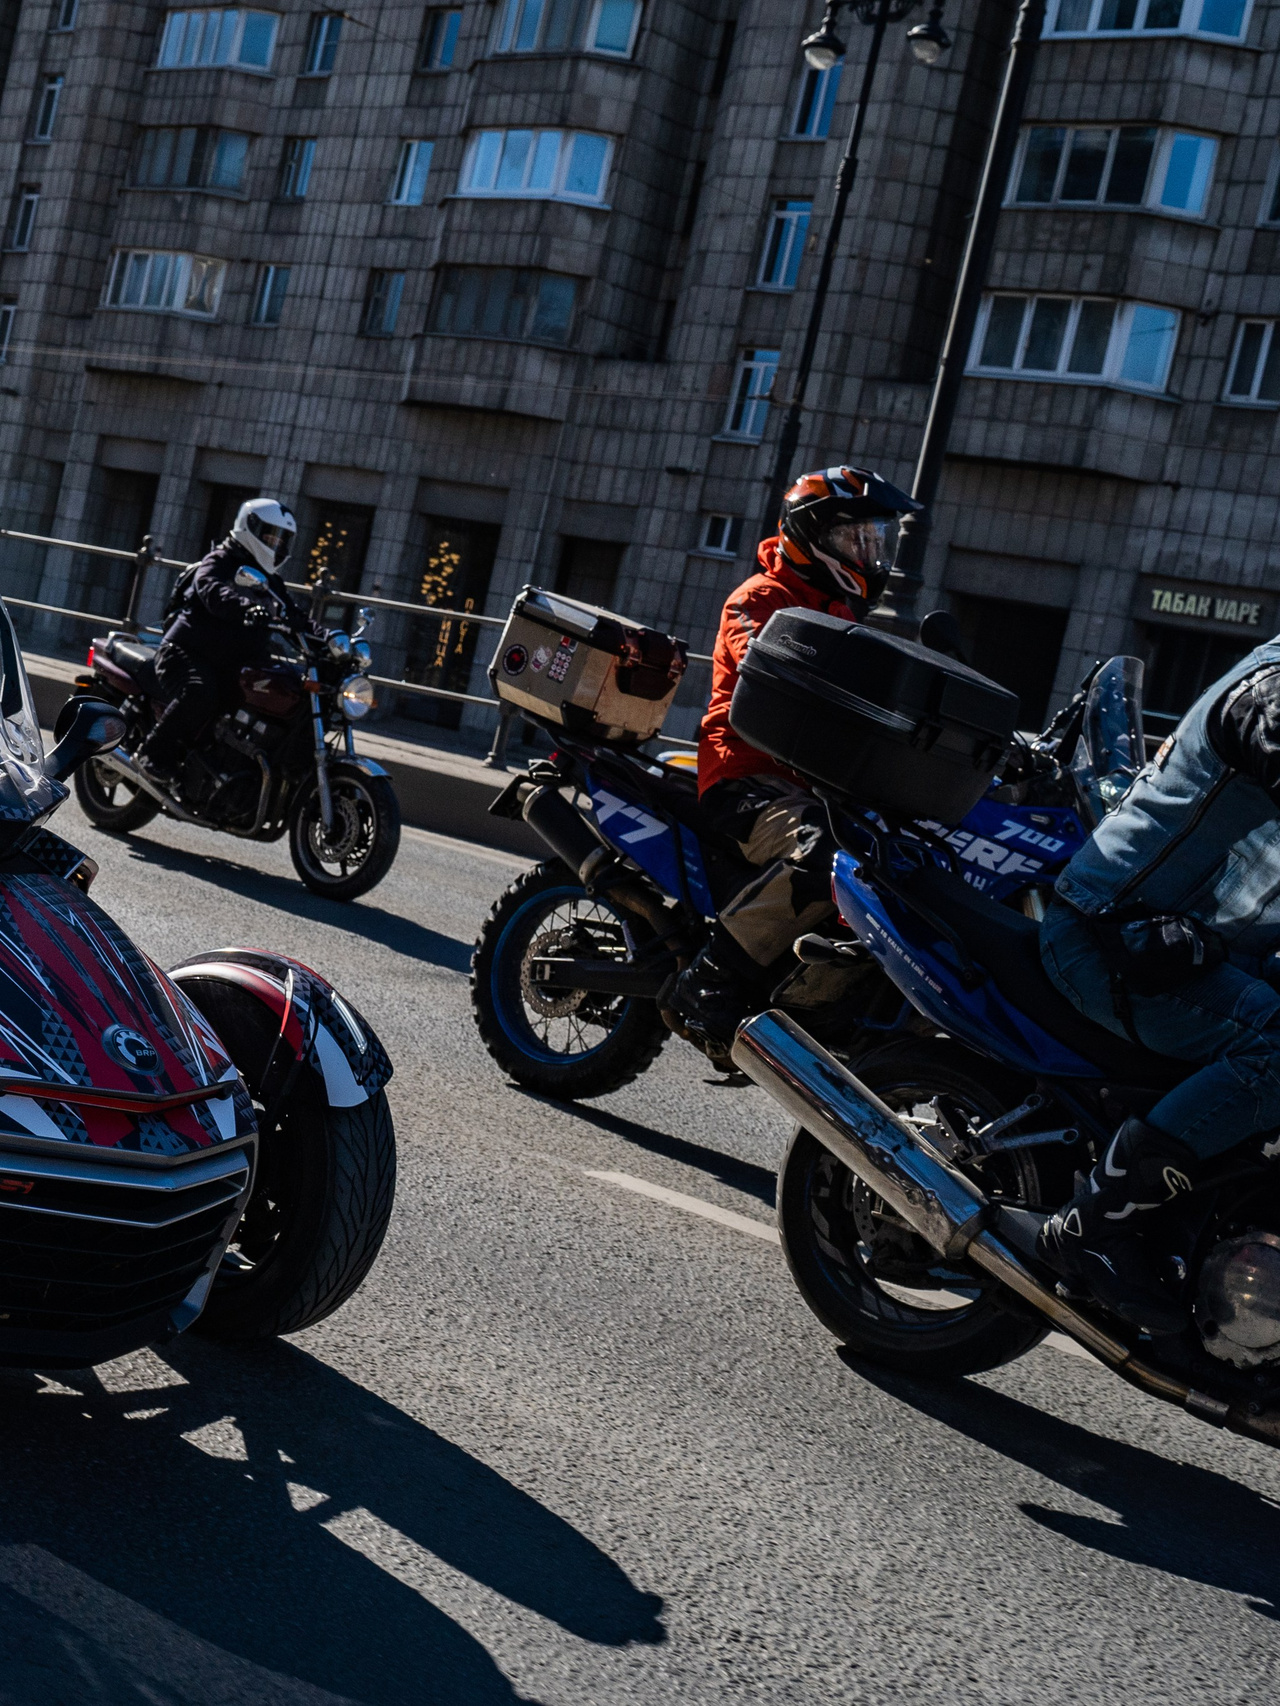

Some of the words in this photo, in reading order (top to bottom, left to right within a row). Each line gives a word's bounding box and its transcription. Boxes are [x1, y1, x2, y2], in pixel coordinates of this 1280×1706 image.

[1151, 588, 1212, 618] ТАБАК
[1213, 598, 1261, 626] VAPE
[592, 789, 669, 844] T7
[993, 818, 1066, 853] 700
[887, 936, 904, 956] VALVE
[135, 1049, 156, 1057] BRP
